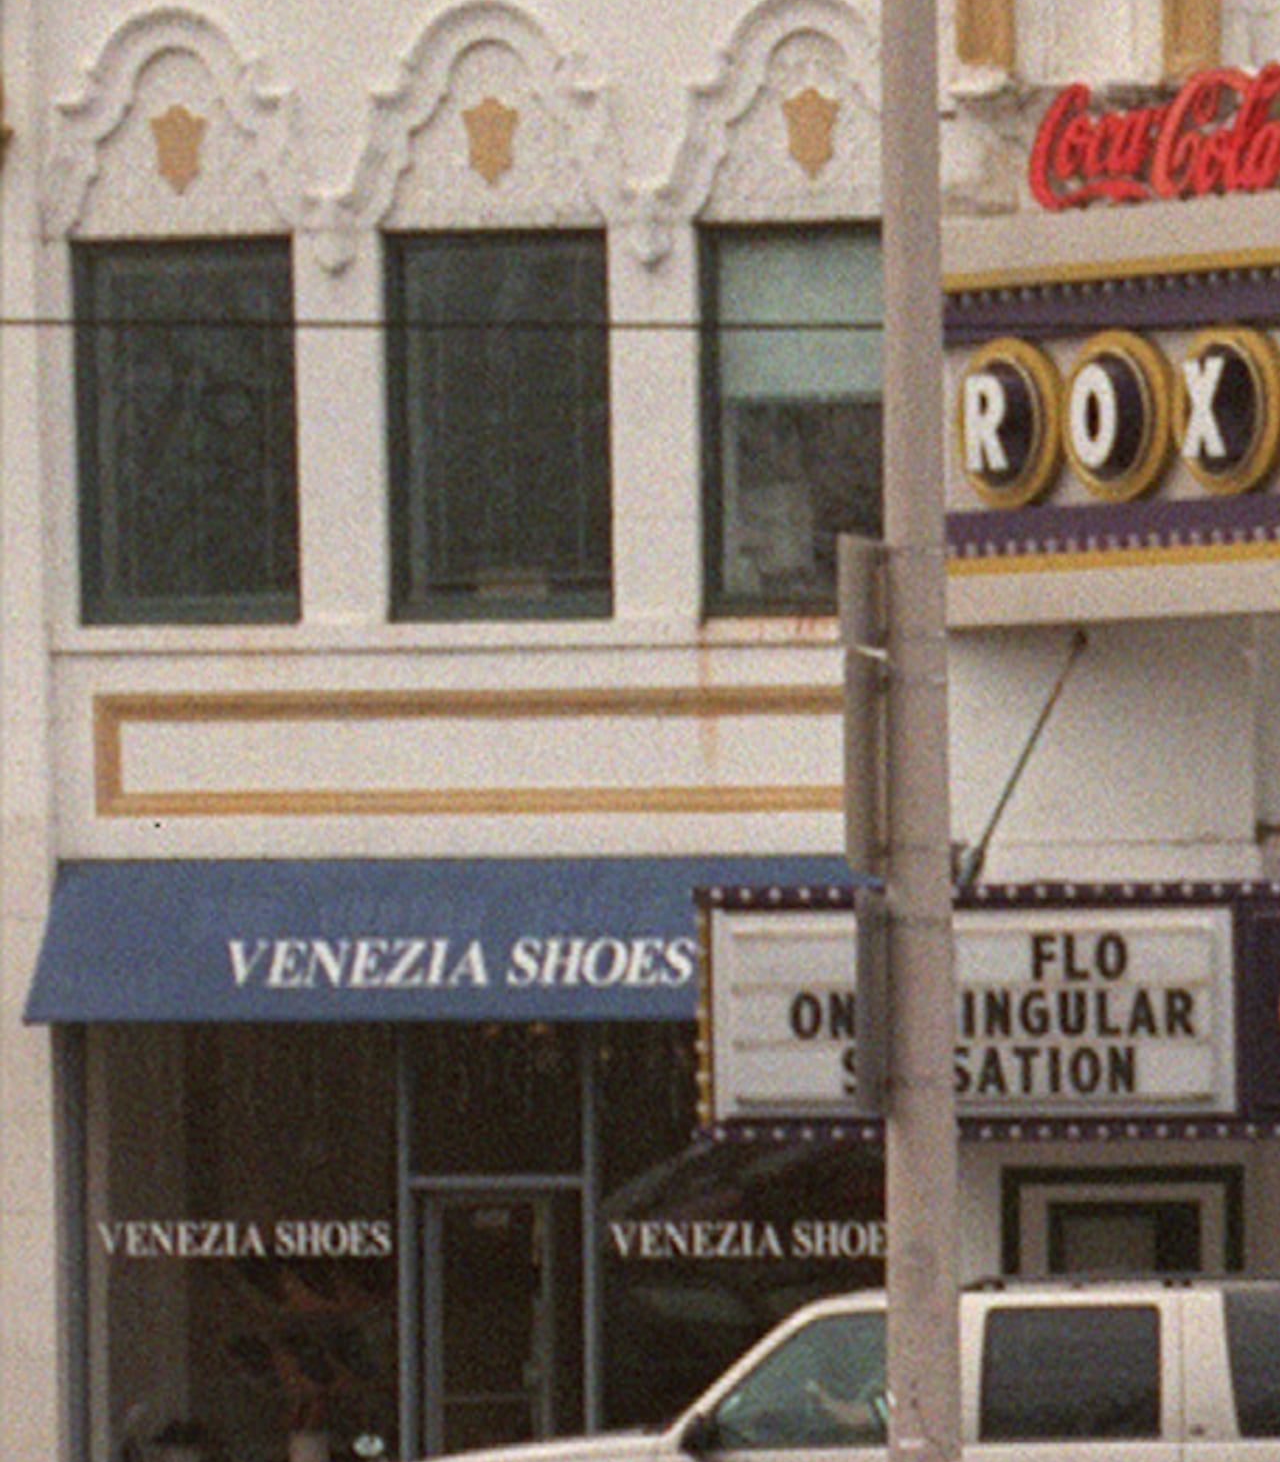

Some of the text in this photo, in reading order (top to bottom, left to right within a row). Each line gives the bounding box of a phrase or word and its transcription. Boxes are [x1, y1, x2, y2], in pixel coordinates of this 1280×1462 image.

[227, 937, 697, 990] VENEZIA SHOES
[1031, 933, 1129, 983] FLO
[98, 1220, 392, 1259] VENEZIA SHOES
[611, 1219, 888, 1259] VENEZIA SHOE
